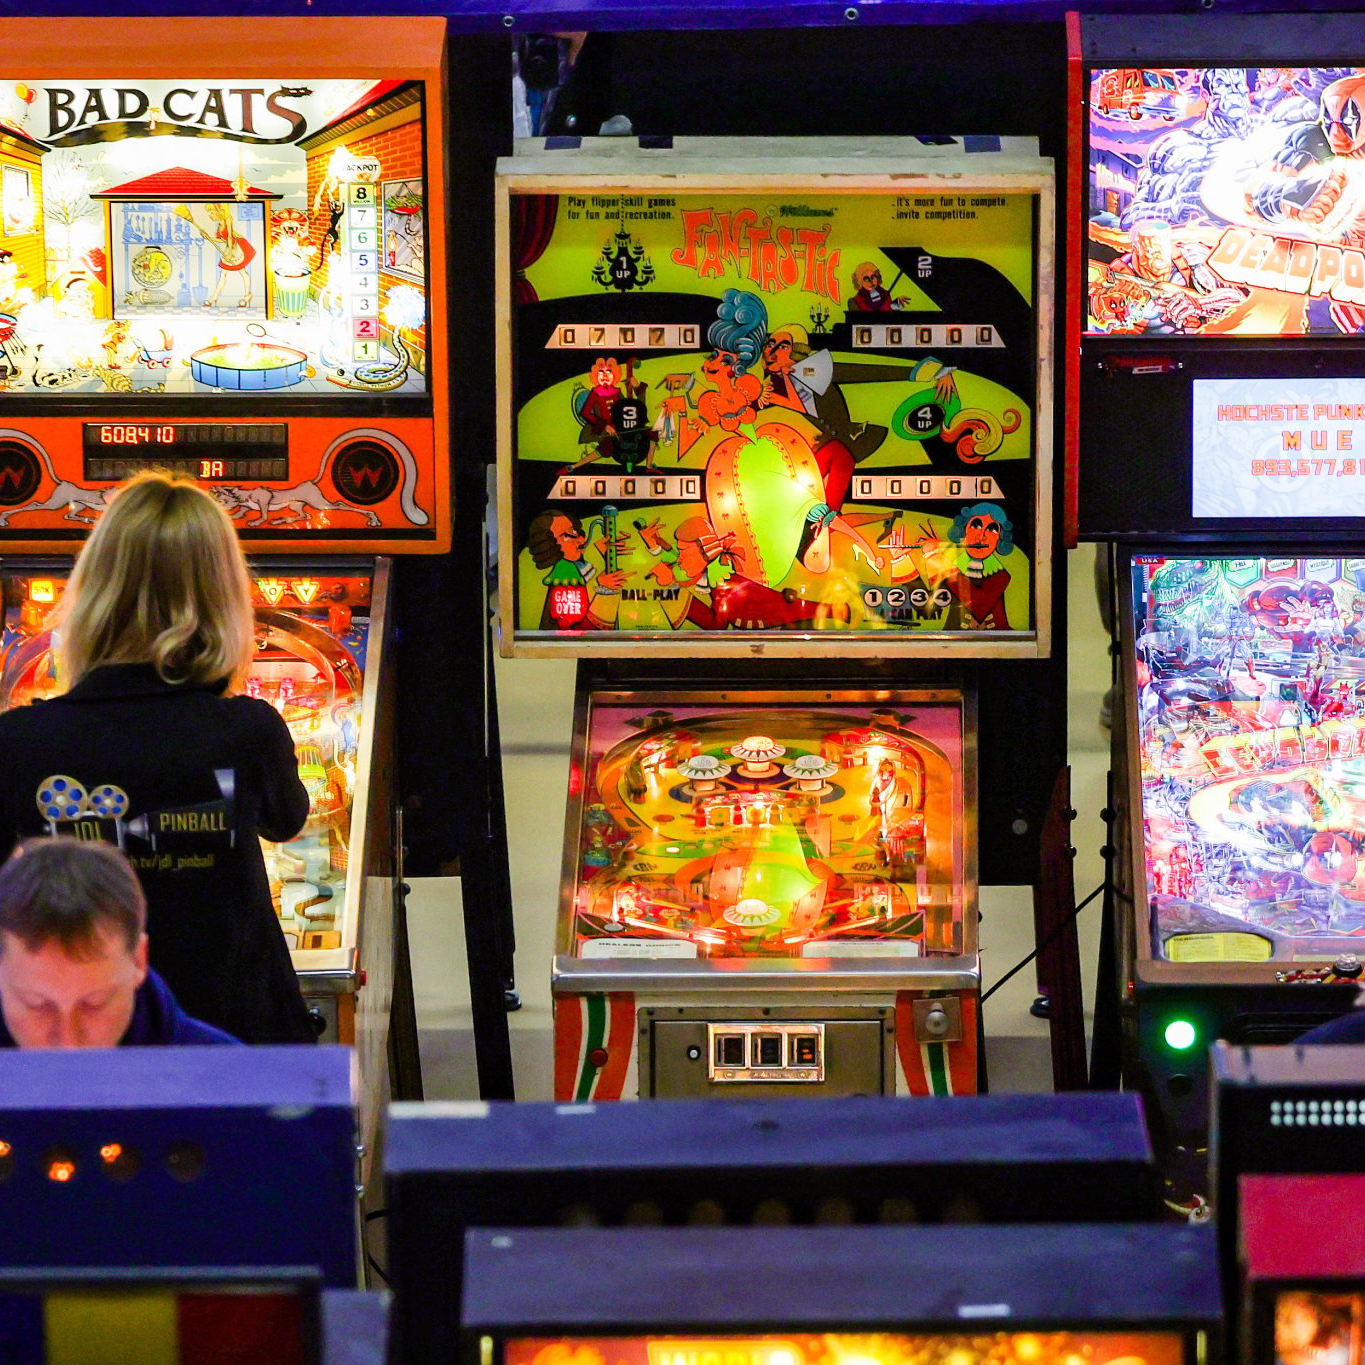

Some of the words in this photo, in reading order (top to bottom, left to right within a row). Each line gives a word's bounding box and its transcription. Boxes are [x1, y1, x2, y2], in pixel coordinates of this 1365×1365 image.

[43, 86, 151, 136] BAD
[162, 84, 314, 144] CATS
[357, 187, 367, 199] 8
[624, 196, 643, 206] skill
[648, 199, 676, 208] games
[940, 196, 953, 206] fun
[958, 196, 966, 206] to
[568, 209, 580, 219] for
[586, 209, 600, 219] fun
[605, 209, 620, 219] and
[358, 232, 368, 244] 6
[359, 254, 368, 267] 5
[619, 257, 627, 269] 1
[918, 256, 931, 269] 2
[918, 270, 931, 278] UP
[360, 321, 370, 333] 2
[362, 343, 369, 355] 1
[623, 407, 636, 419] 3
[918, 408, 931, 420] 4
[623, 420, 637, 428] UP
[554, 590, 581, 602] GAME
[622, 589, 647, 601] BALL
[653, 589, 680, 601] PLAY
[556, 603, 581, 614] OVER
[160, 812, 227, 832] PINBALL
